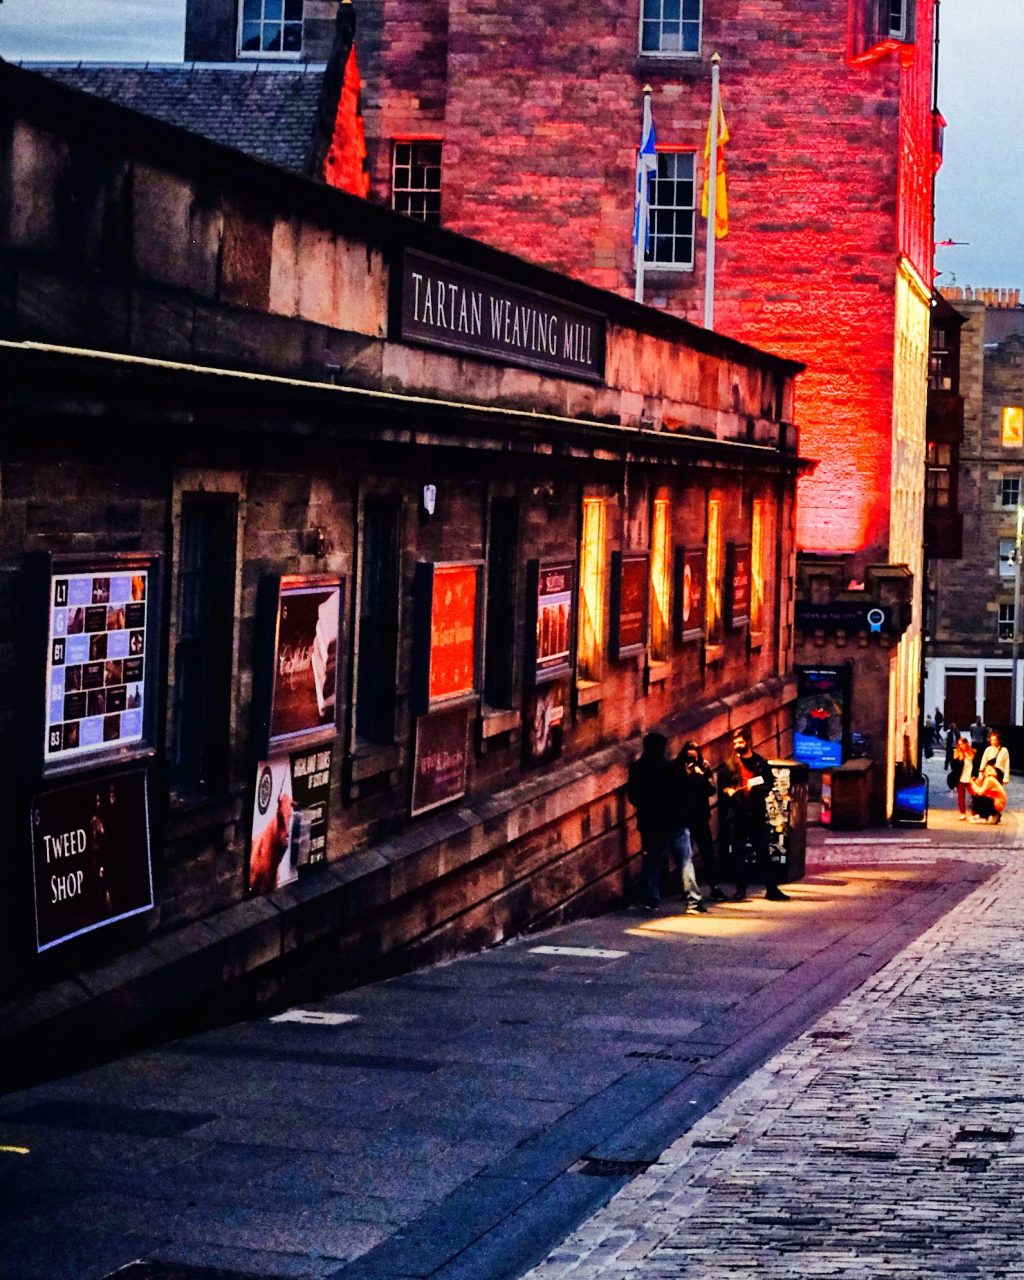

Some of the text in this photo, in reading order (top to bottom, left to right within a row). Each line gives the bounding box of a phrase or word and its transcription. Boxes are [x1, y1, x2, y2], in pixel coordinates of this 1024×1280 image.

[411, 272, 592, 365] TARTAN WEAVING MILL
[57, 584, 66, 602] L1
[54, 643, 63, 661] B1
[50, 728, 60, 747] B3
[43, 828, 87, 863] TWEED
[50, 870, 84, 904] SHOP
